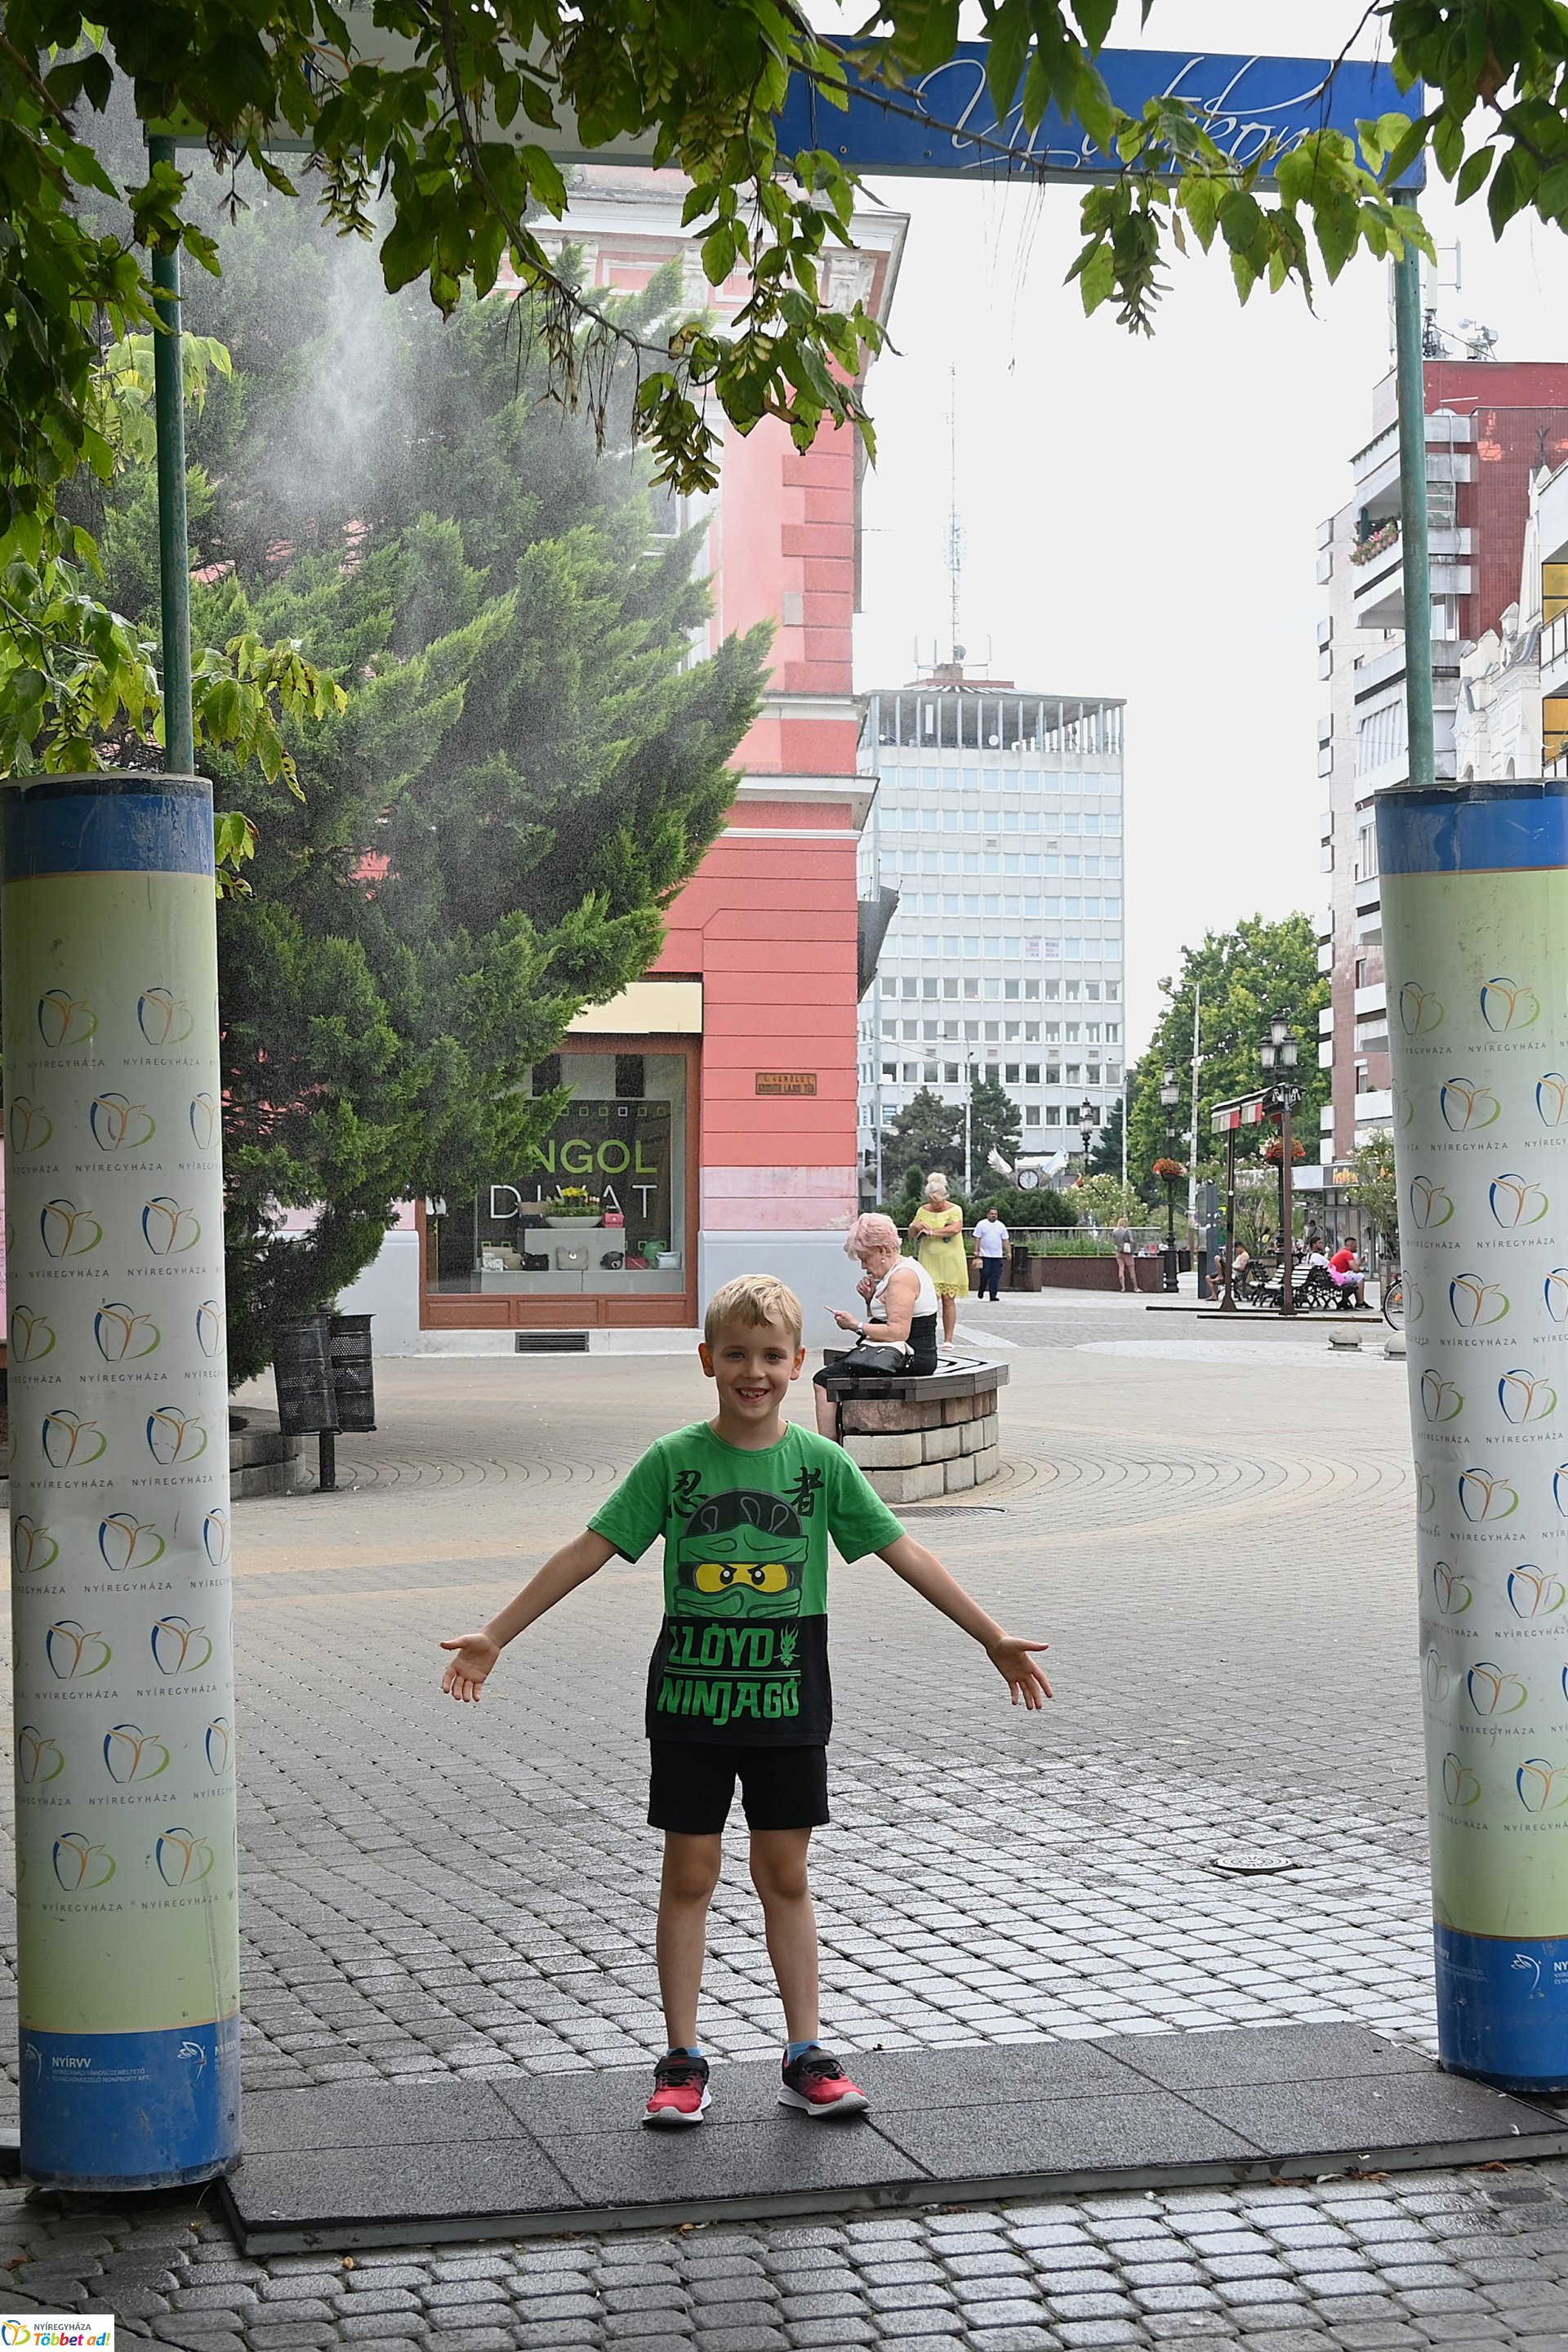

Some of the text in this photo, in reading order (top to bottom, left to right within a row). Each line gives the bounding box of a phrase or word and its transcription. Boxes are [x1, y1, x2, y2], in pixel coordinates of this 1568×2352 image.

[1398, 1041, 1547, 1054] ÍREGYHÁZA NYÍREGYHÁZA
[123, 1057, 200, 1067] NYÍREGYHÁZA
[1430, 1142, 1508, 1152] NYÍREGYHÁZA
[529, 1139, 657, 1174] NGOL
[76, 1161, 163, 1173] NYÍREGYHÁZA
[1477, 1237, 1556, 1249] NYÍREGYHÁZA
[29, 1268, 109, 1278] NYÍREGYHÁZA
[127, 1267, 206, 1276] NYÍREGYHÁZA
[1440, 1338, 1517, 1347] NYÍREGYHÁZA
[79, 1372, 167, 1383] NYÍREGYHÁZA
[1486, 1432, 1563, 1444] NYÍREGYHÁZA
[30, 1480, 114, 1489] NYÍREGYHÁZA
[131, 1476, 214, 1486] NYÍREGYHÁZA
[1450, 1531, 1526, 1542] NYÍREGYHÁZA
[84, 1582, 172, 1592] NYÍREGYHÁZA
[669, 1623, 775, 1667] LLOYD
[35, 1690, 118, 1699] NYÍREGYHÁZA
[136, 1685, 216, 1697] NYÍREGYHÁZA
[657, 1677, 800, 1726] NINJAGO
[1459, 1724, 1535, 1735] NYÍREGYHÁZA
[89, 1794, 176, 1806] NYÍREGYHÁZA
[42, 1902, 122, 1913] NYÍREGYHÁZA
[141, 1895, 219, 1910] NYÍREGYHÁZA
[51, 2055, 91, 2068] NYÍRVV
